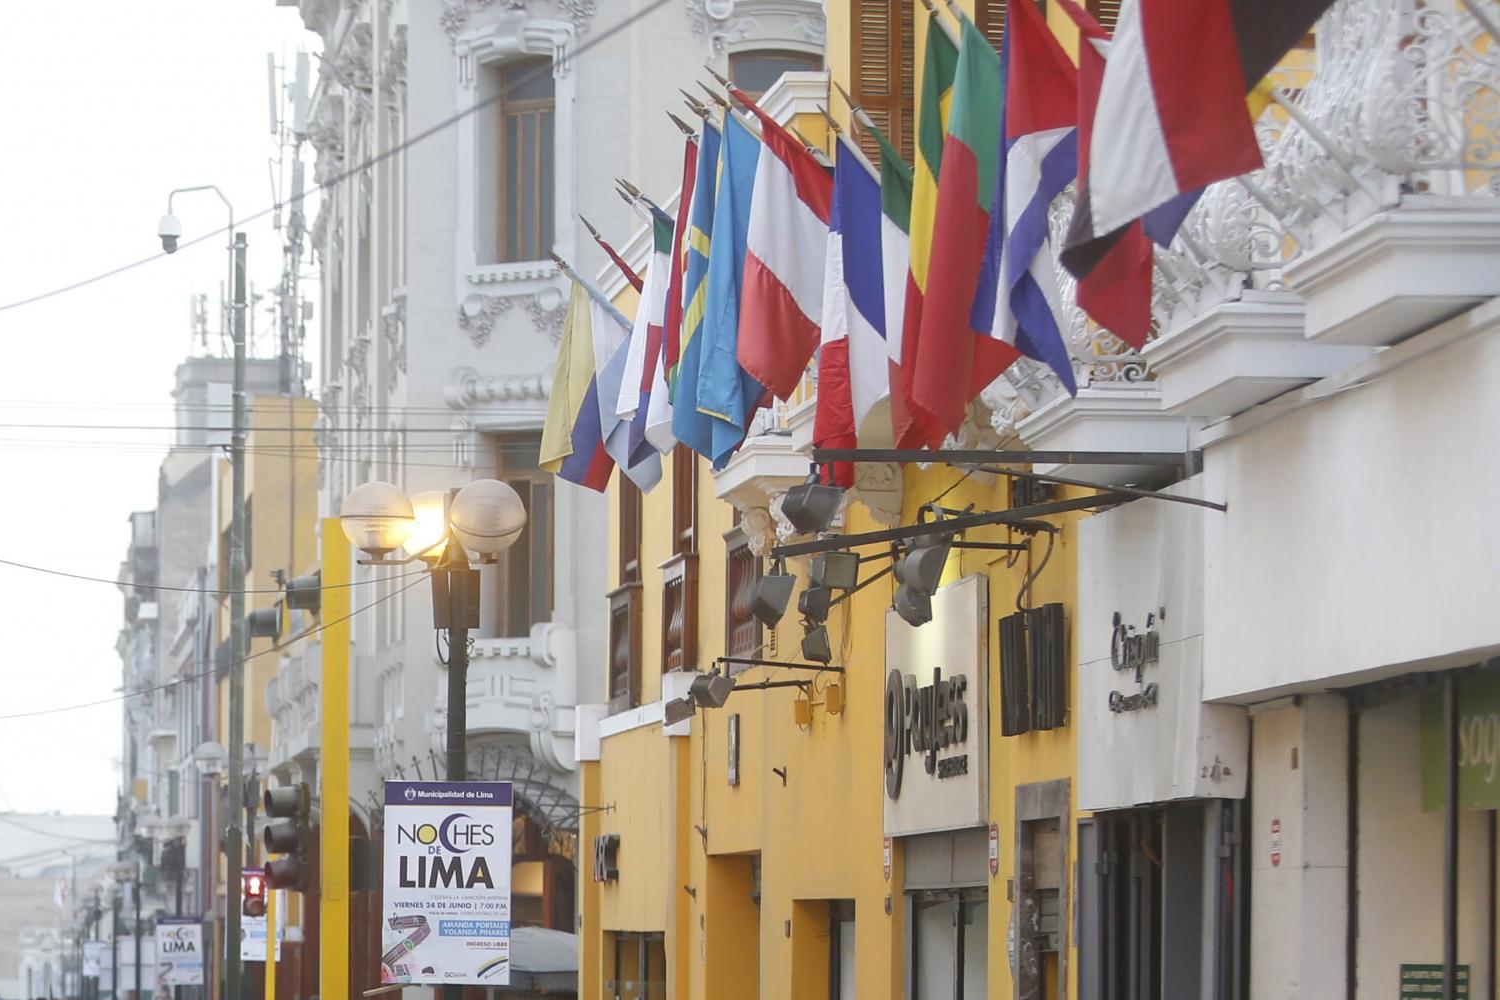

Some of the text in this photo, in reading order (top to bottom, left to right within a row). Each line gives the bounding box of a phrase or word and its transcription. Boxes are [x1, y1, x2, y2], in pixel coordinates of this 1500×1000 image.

[904, 667, 968, 775] Payless
[418, 790, 493, 798] Municipalidad de Lima
[398, 813, 494, 853] NOCHES
[428, 846, 442, 854] DE
[399, 856, 494, 888] LIMA
[476, 921, 508, 929] PORTALES
[163, 941, 195, 952] LIMA
